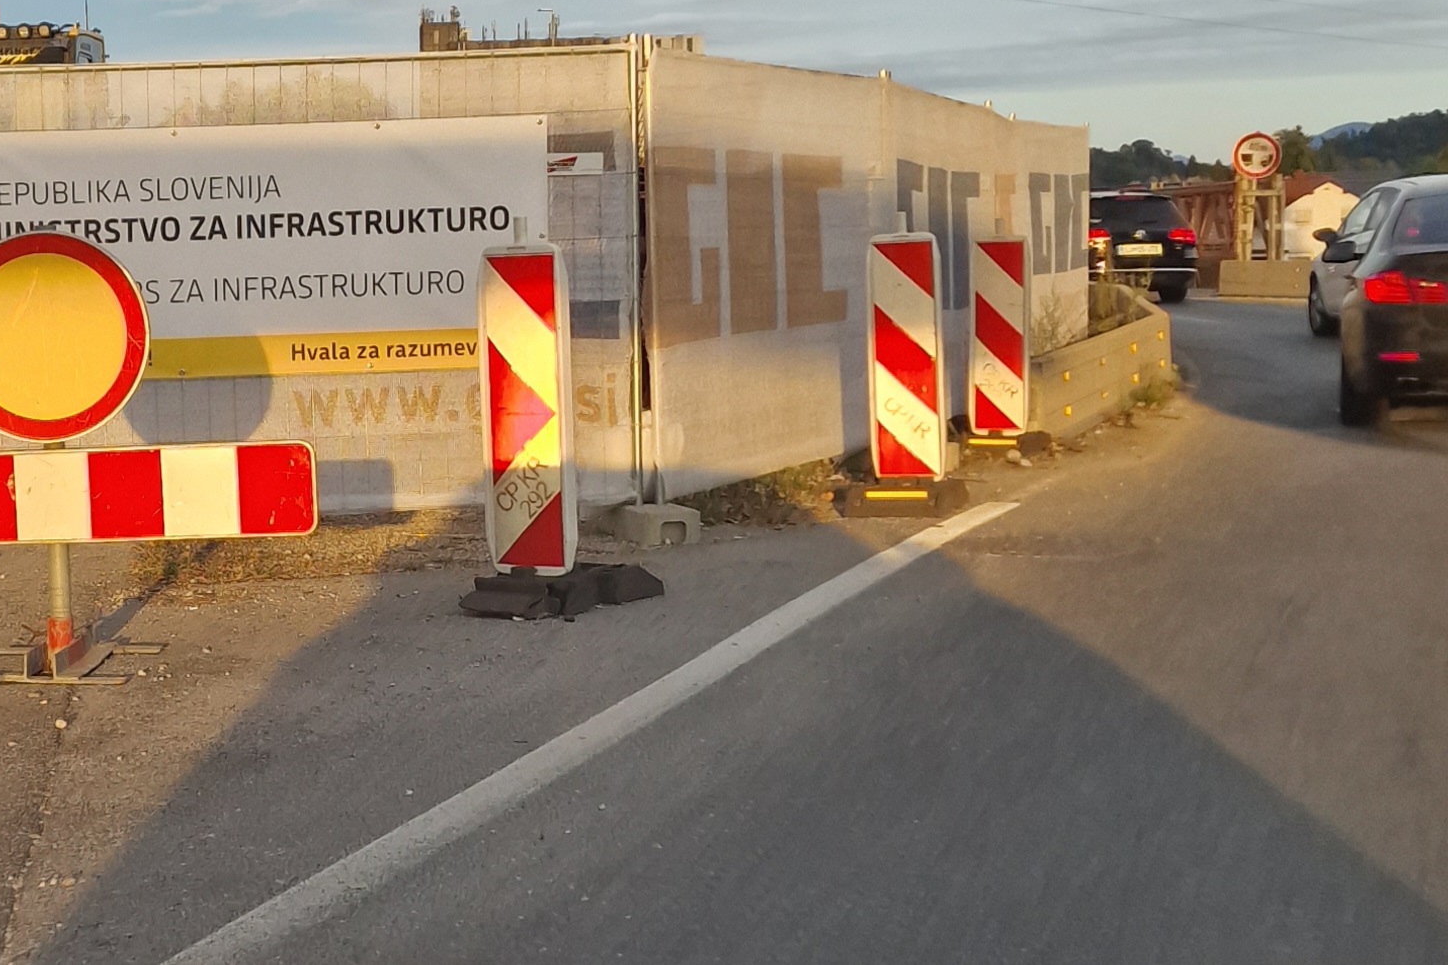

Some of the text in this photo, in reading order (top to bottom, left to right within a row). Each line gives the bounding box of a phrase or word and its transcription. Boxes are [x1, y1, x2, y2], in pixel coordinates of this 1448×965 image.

[139, 175, 282, 204] SLOVENIJA
[189, 214, 229, 241] ZA
[236, 205, 510, 240] INFRASTRUKTURO
[169, 278, 205, 304] ZA
[213, 269, 466, 302] INFRASTRUKTURO
[291, 340, 351, 362] Hvala
[356, 342, 380, 359] za
[519, 480, 553, 520] 292
